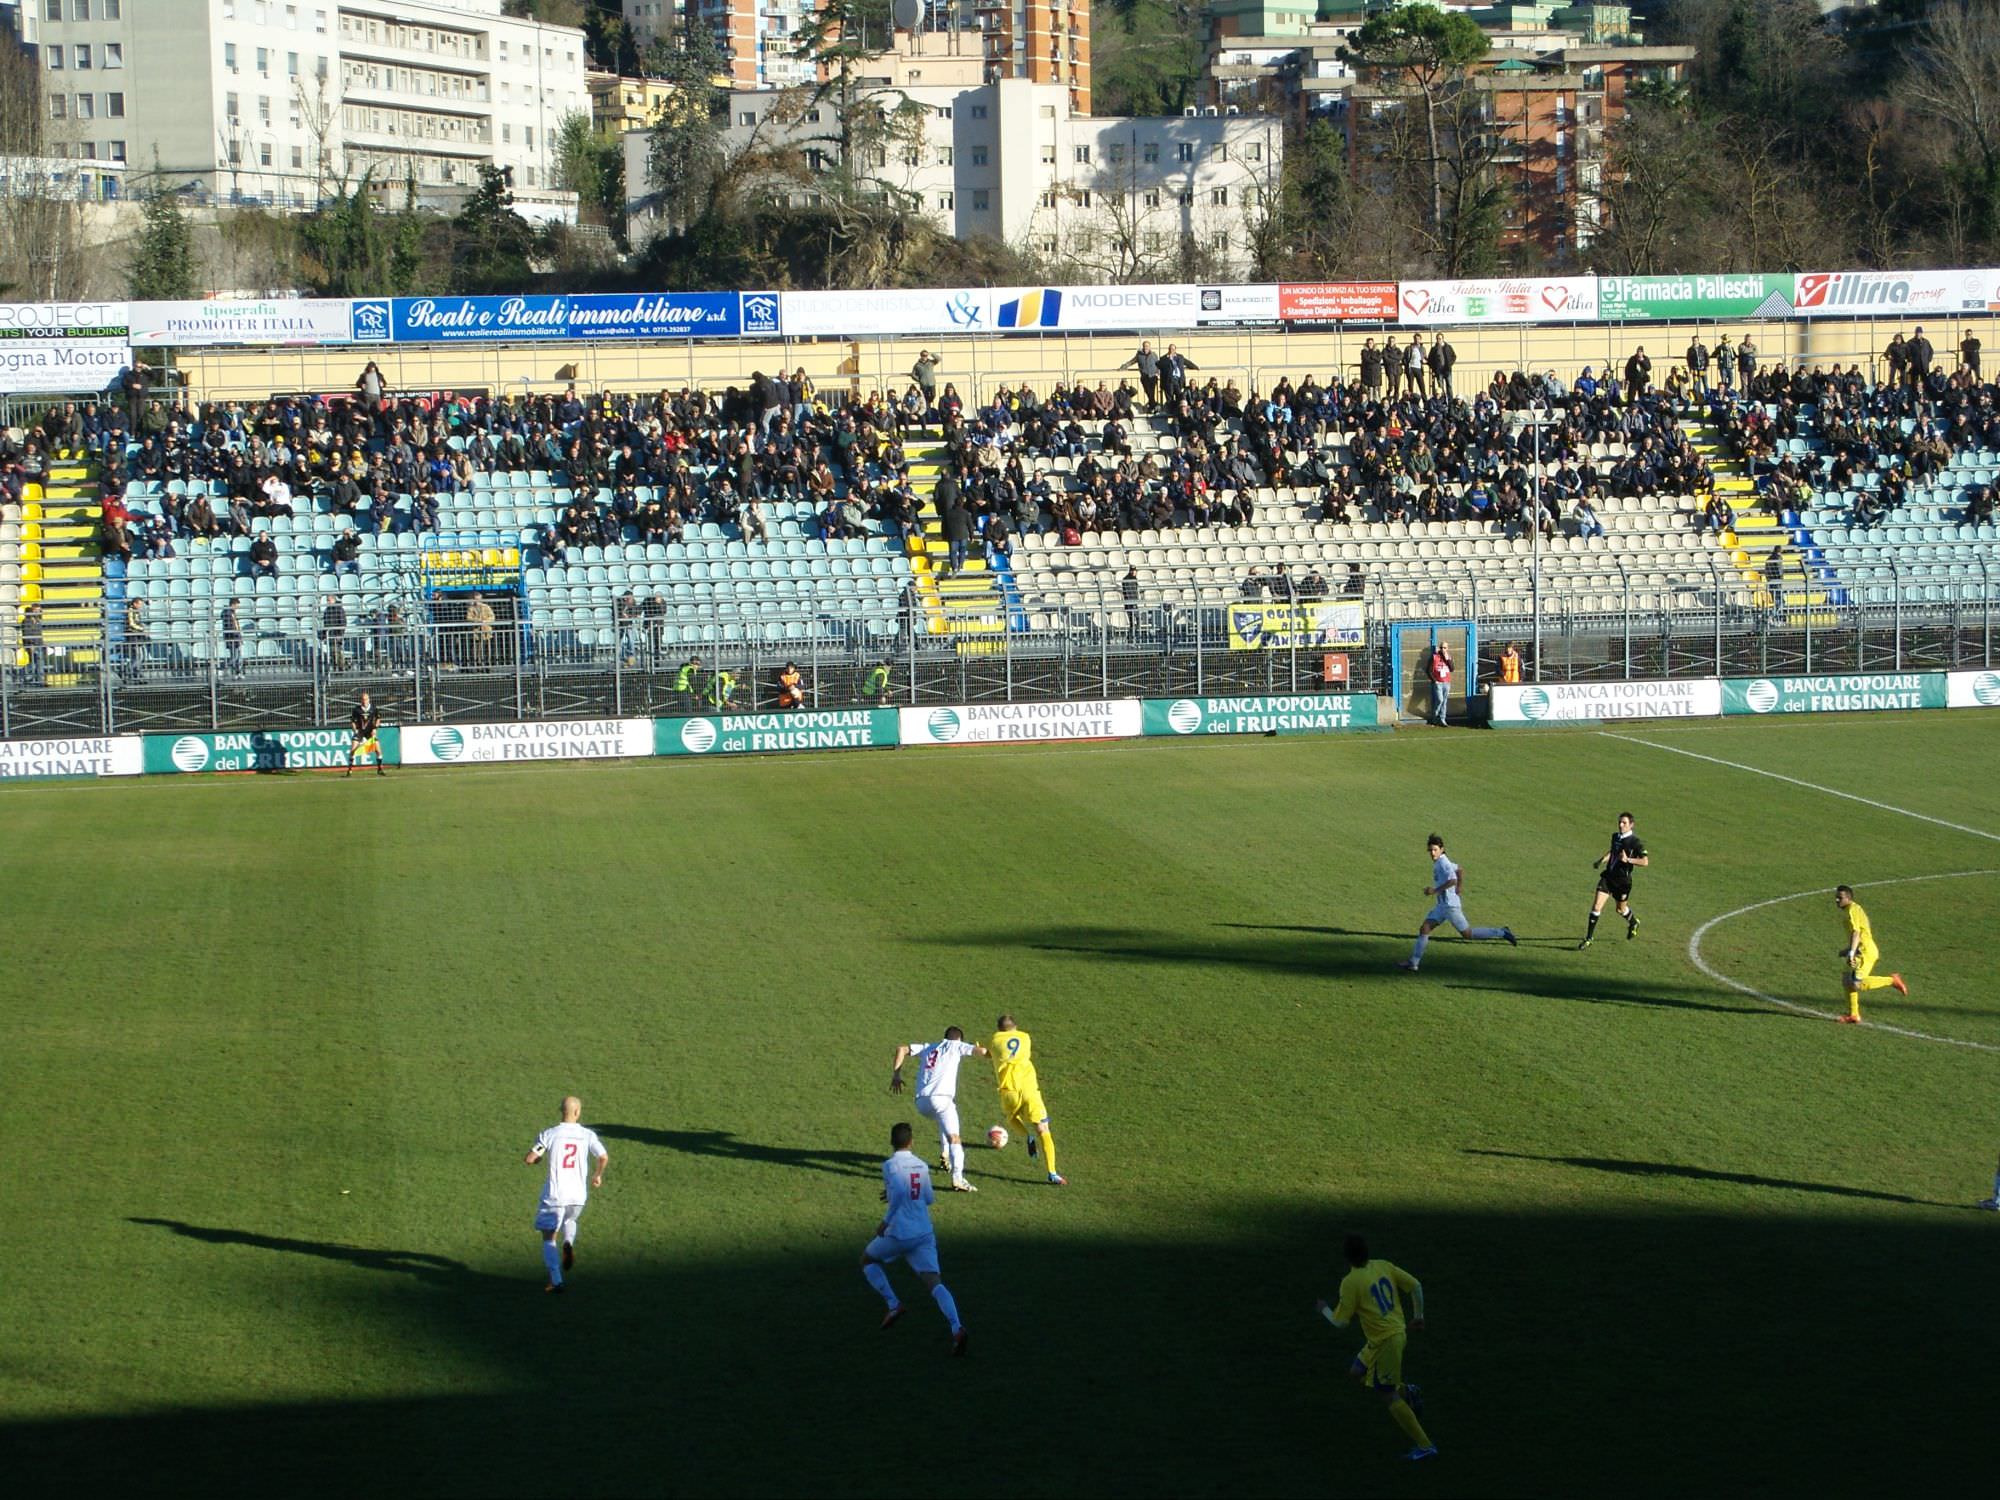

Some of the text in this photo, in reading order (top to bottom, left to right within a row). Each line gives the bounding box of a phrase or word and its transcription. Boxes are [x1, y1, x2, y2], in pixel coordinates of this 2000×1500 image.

[1623, 276, 1763, 301] Farmacia Palleschi
[786, 299, 842, 314] STUDIO
[1072, 292, 1193, 308] MODENESE
[1299, 296, 1382, 306] Spedizioni Imballaggio
[203, 302, 277, 318] tipografia
[407, 299, 478, 327] Reali
[479, 312, 493, 326] e
[497, 298, 567, 325] Reali
[569, 297, 708, 325] immobiliare
[1287, 307, 1314, 316] Stampa
[1315, 306, 1342, 316] Digitale
[27, 328, 64, 337] YOUR
[67, 327, 127, 336] BUILDING
[166, 317, 314, 331] PROMOTER ITALIA
[54, 347, 125, 366] Motori
[1556, 682, 1694, 700] BANCA POPOLARE
[1783, 674, 1921, 694] BANCA POPOLARE
[967, 702, 1113, 721] BANCA POPOLARE
[1208, 695, 1352, 713] BANCA POPOLARE
[1556, 700, 1694, 719] del FRUSINATE
[1783, 692, 1921, 712] del FRUSINATE
[472, 720, 624, 740] BANCA POPOLARE
[722, 710, 872, 731] BANCA POPOLARE
[967, 720, 1114, 740] del FRUSINATE
[1208, 719, 1230, 733] del
[20, 739, 113, 757] POPOLARE
[215, 733, 275, 751] BANCA
[472, 739, 624, 760] del FRUSINATE
[723, 729, 873, 751] del FRUSINATE
[215, 757, 240, 771] del
[1007, 1038, 1020, 1058] 9
[562, 1143, 577, 1169] 2
[910, 1172, 921, 1201] 5
[1370, 1276, 1394, 1313] 10
